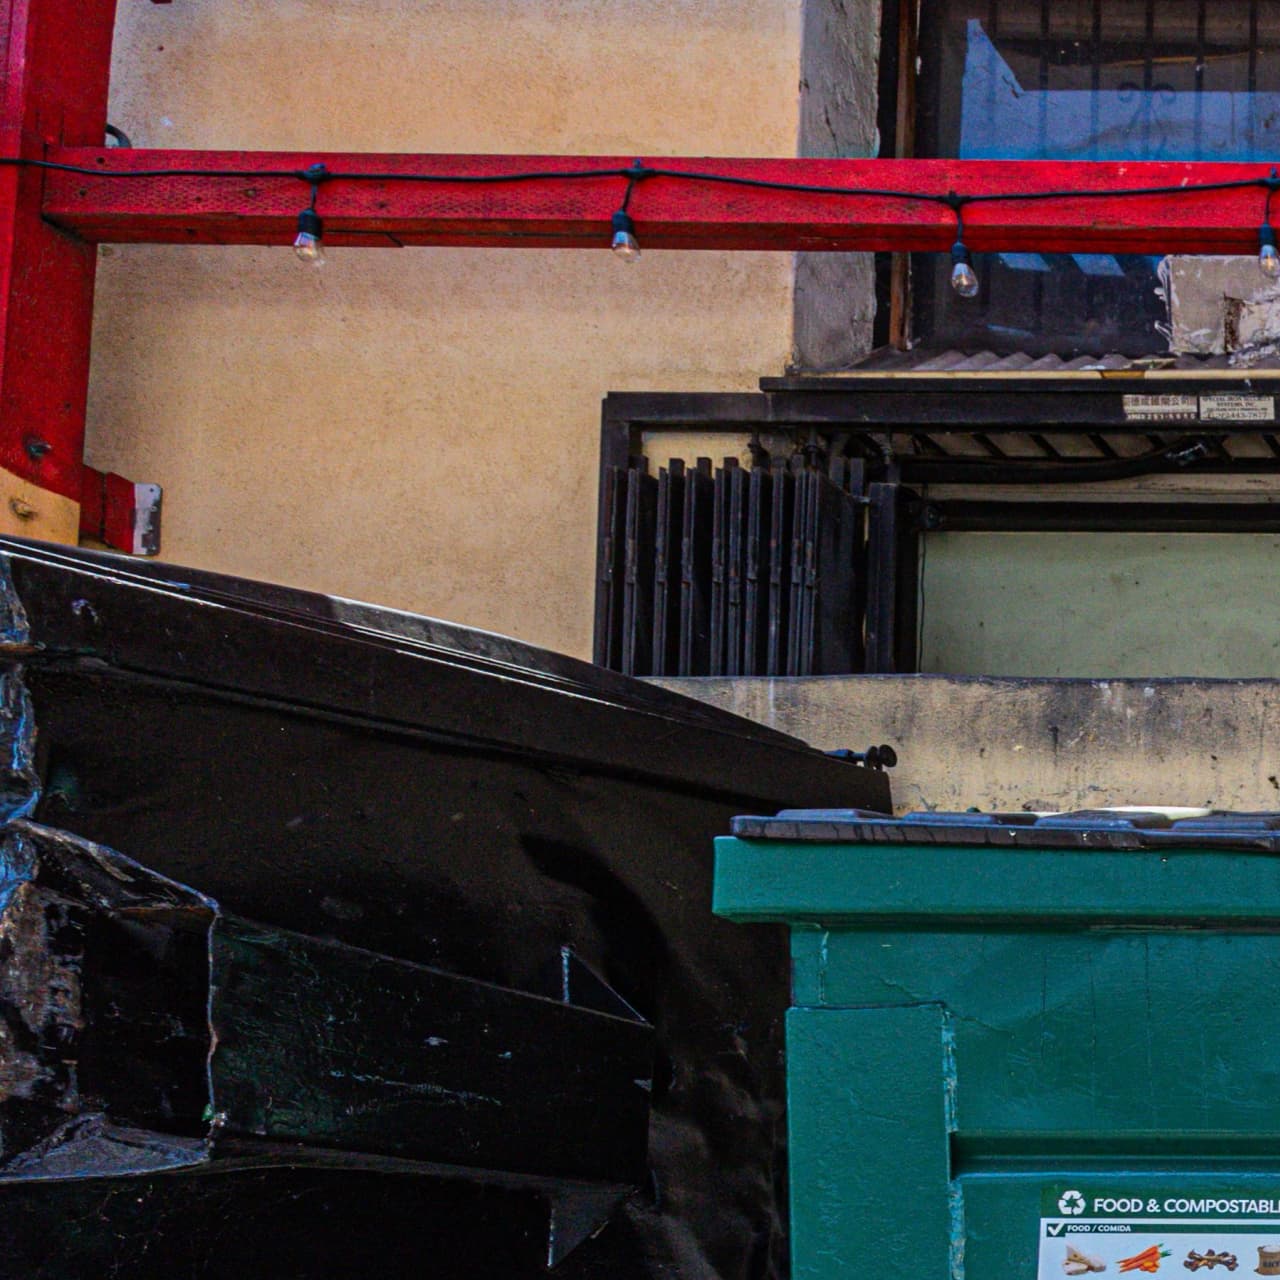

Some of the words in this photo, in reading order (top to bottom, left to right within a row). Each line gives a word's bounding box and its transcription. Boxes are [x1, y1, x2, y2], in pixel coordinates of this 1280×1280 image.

[1094, 1199, 1143, 1212] FOOD
[1146, 1199, 1160, 1212] &
[1067, 1225, 1090, 1233] FOOD
[1098, 1225, 1132, 1233] COMIDA
